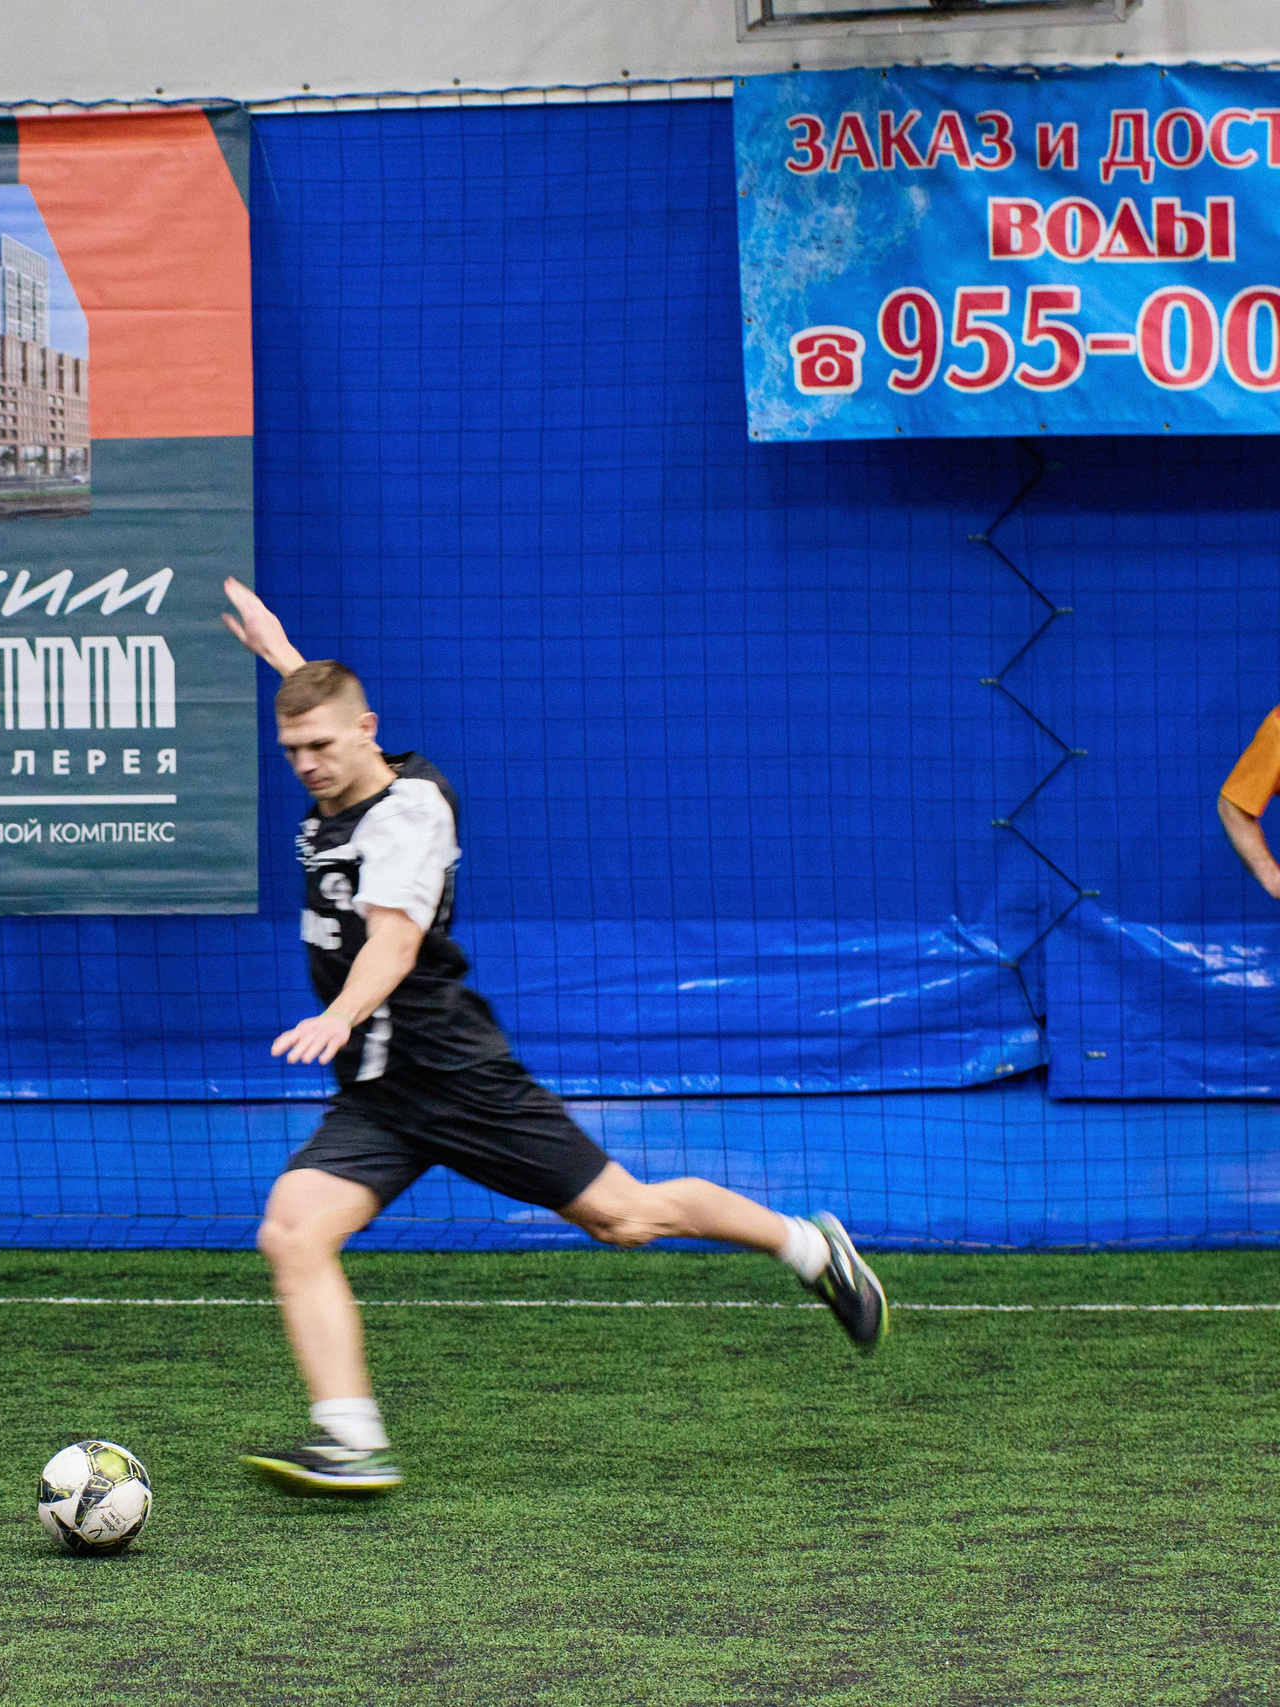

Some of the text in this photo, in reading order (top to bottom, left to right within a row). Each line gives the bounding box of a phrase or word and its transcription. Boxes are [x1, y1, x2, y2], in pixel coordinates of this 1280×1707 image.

[785, 109, 1017, 175] ЗАКАЗ
[1036, 121, 1079, 171] и
[987, 196, 1236, 264] ВОДЫ
[876, 284, 1280, 395] 955-00
[49, 821, 176, 843] КОМПЛЕКС
